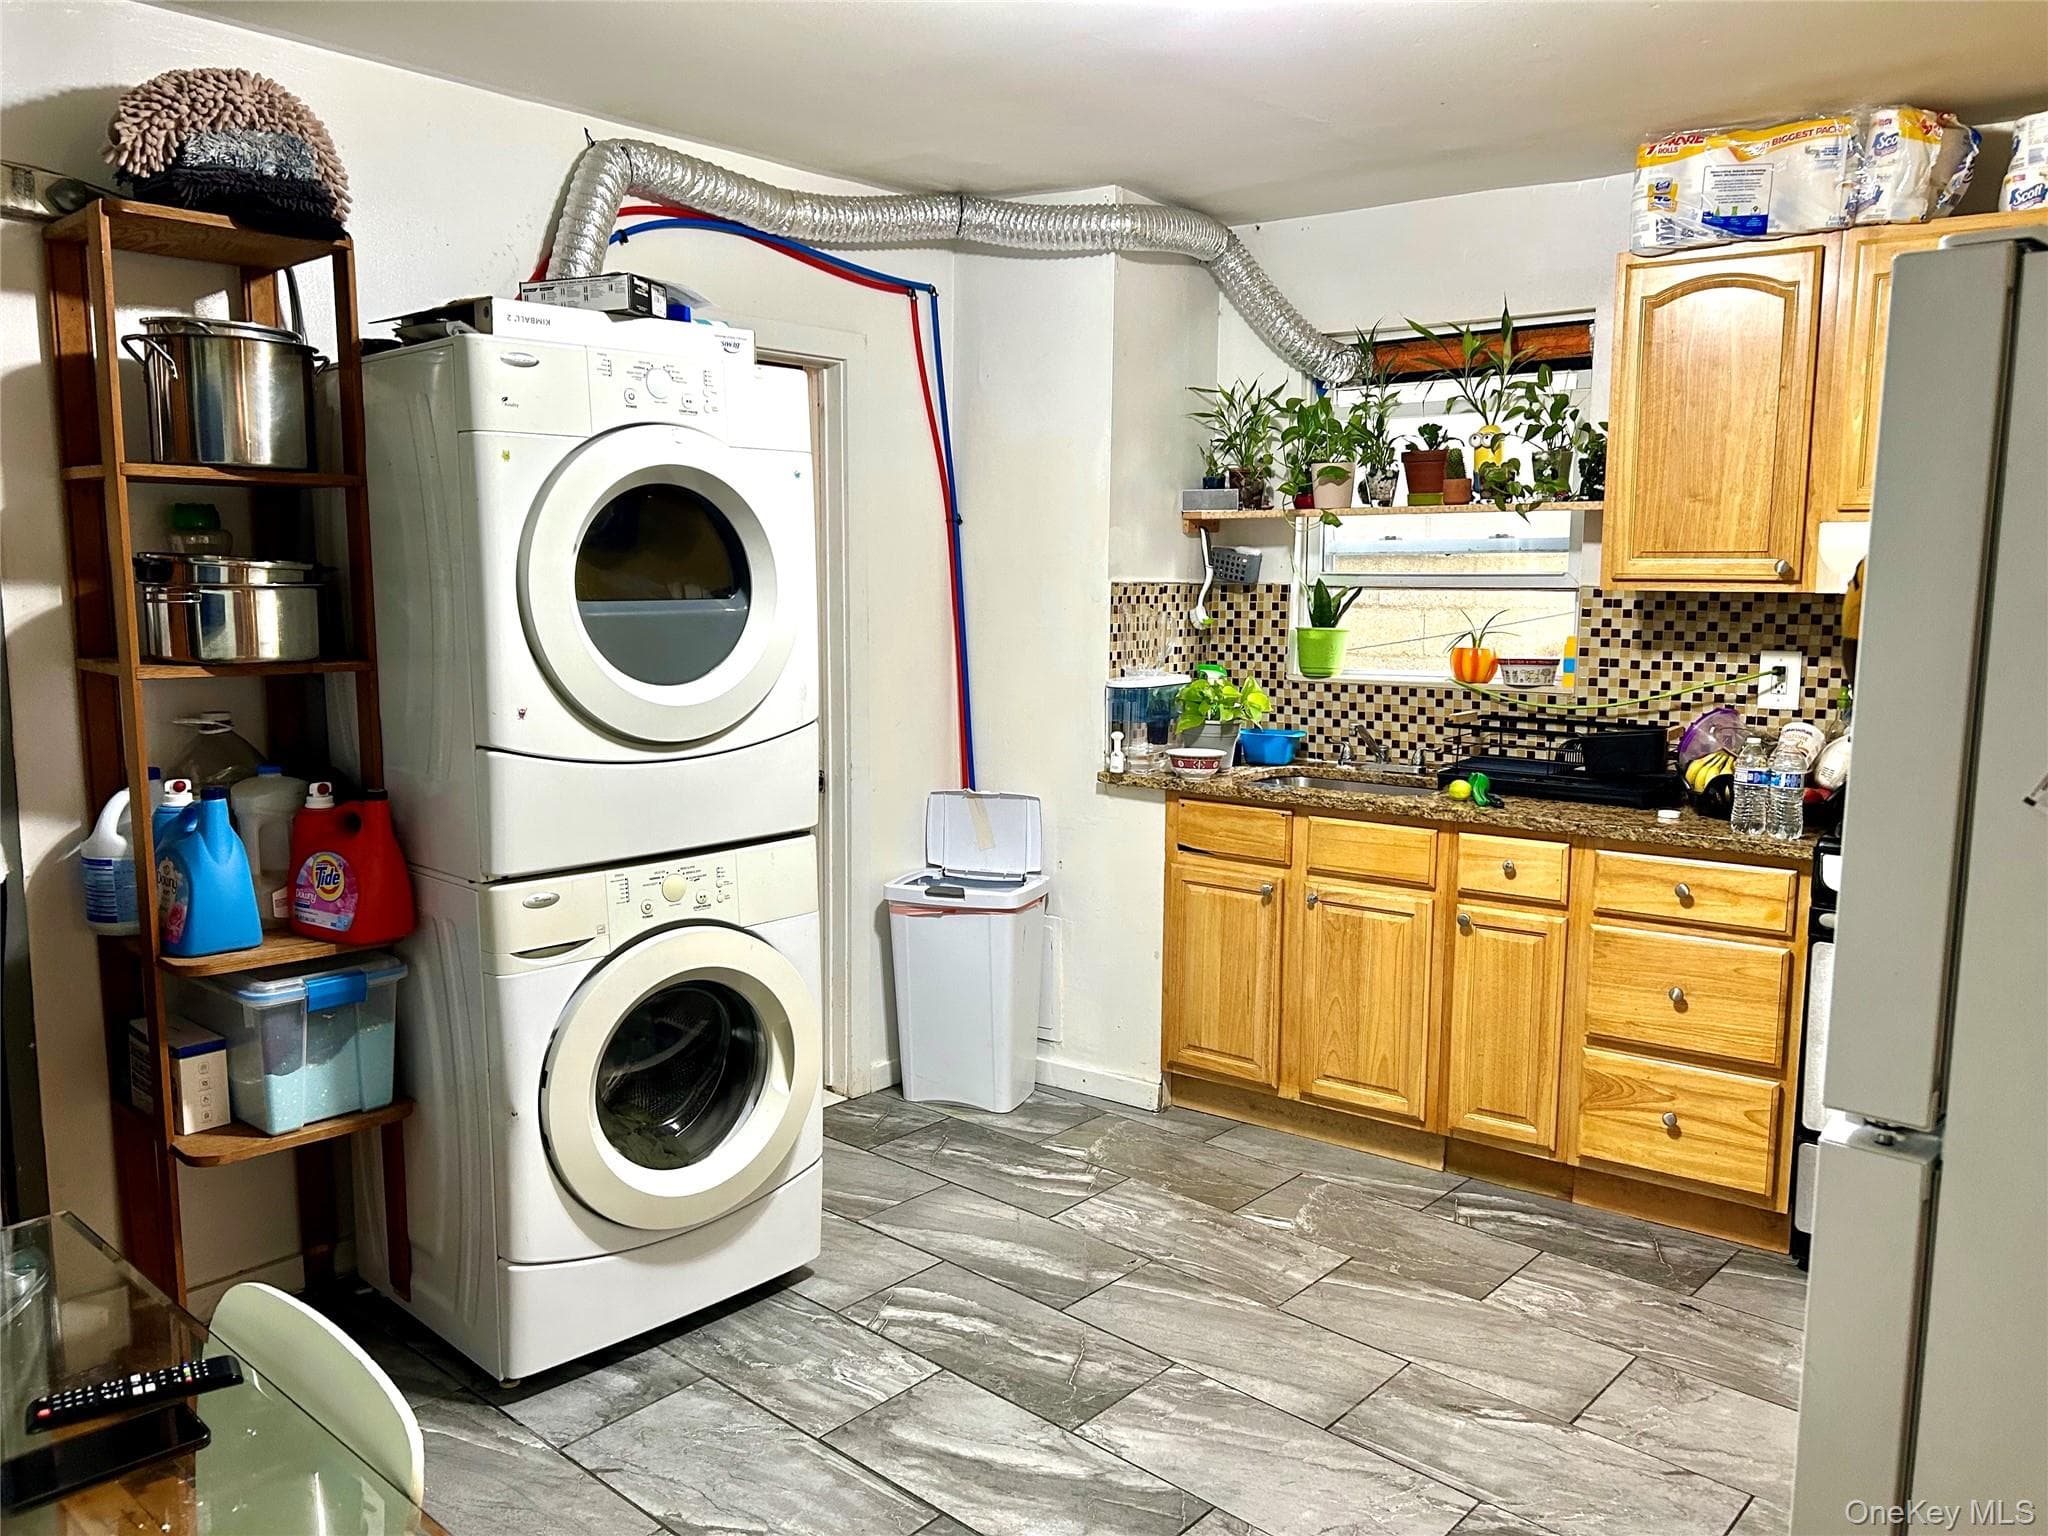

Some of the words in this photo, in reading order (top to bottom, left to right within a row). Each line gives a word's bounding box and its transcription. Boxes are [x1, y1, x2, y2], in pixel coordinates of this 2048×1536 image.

[1771, 129, 1814, 146] BIGGEST
[1876, 135, 1898, 149] Sco
[2013, 184, 2044, 206] Scott
[315, 866, 341, 889] Tide
